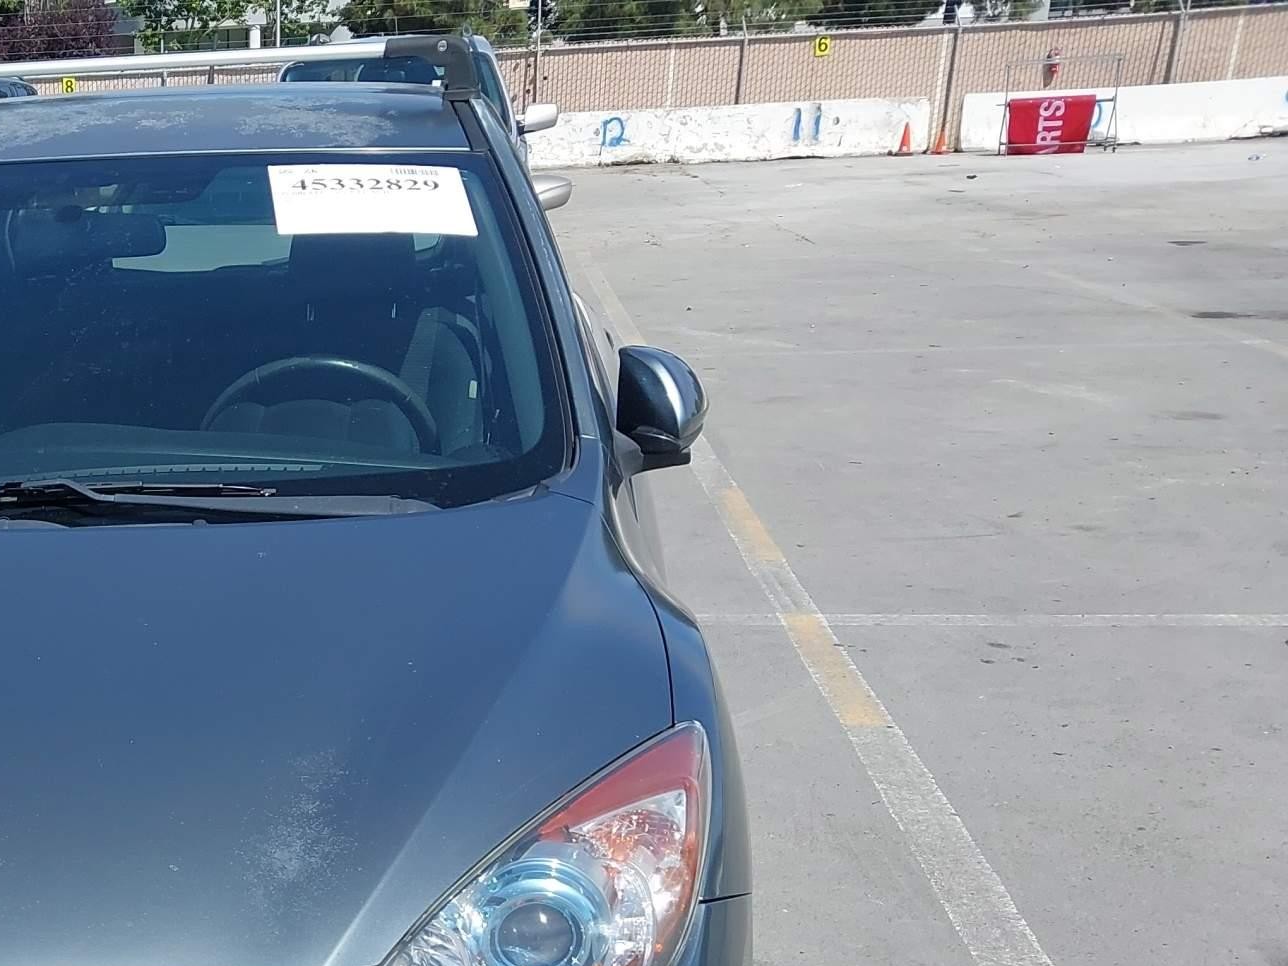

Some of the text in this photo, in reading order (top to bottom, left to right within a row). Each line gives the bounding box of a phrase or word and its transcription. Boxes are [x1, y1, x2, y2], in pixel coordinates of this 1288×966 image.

[818, 36, 828, 52] 6
[65, 79, 74, 93] 8
[291, 178, 440, 191] 45332829
